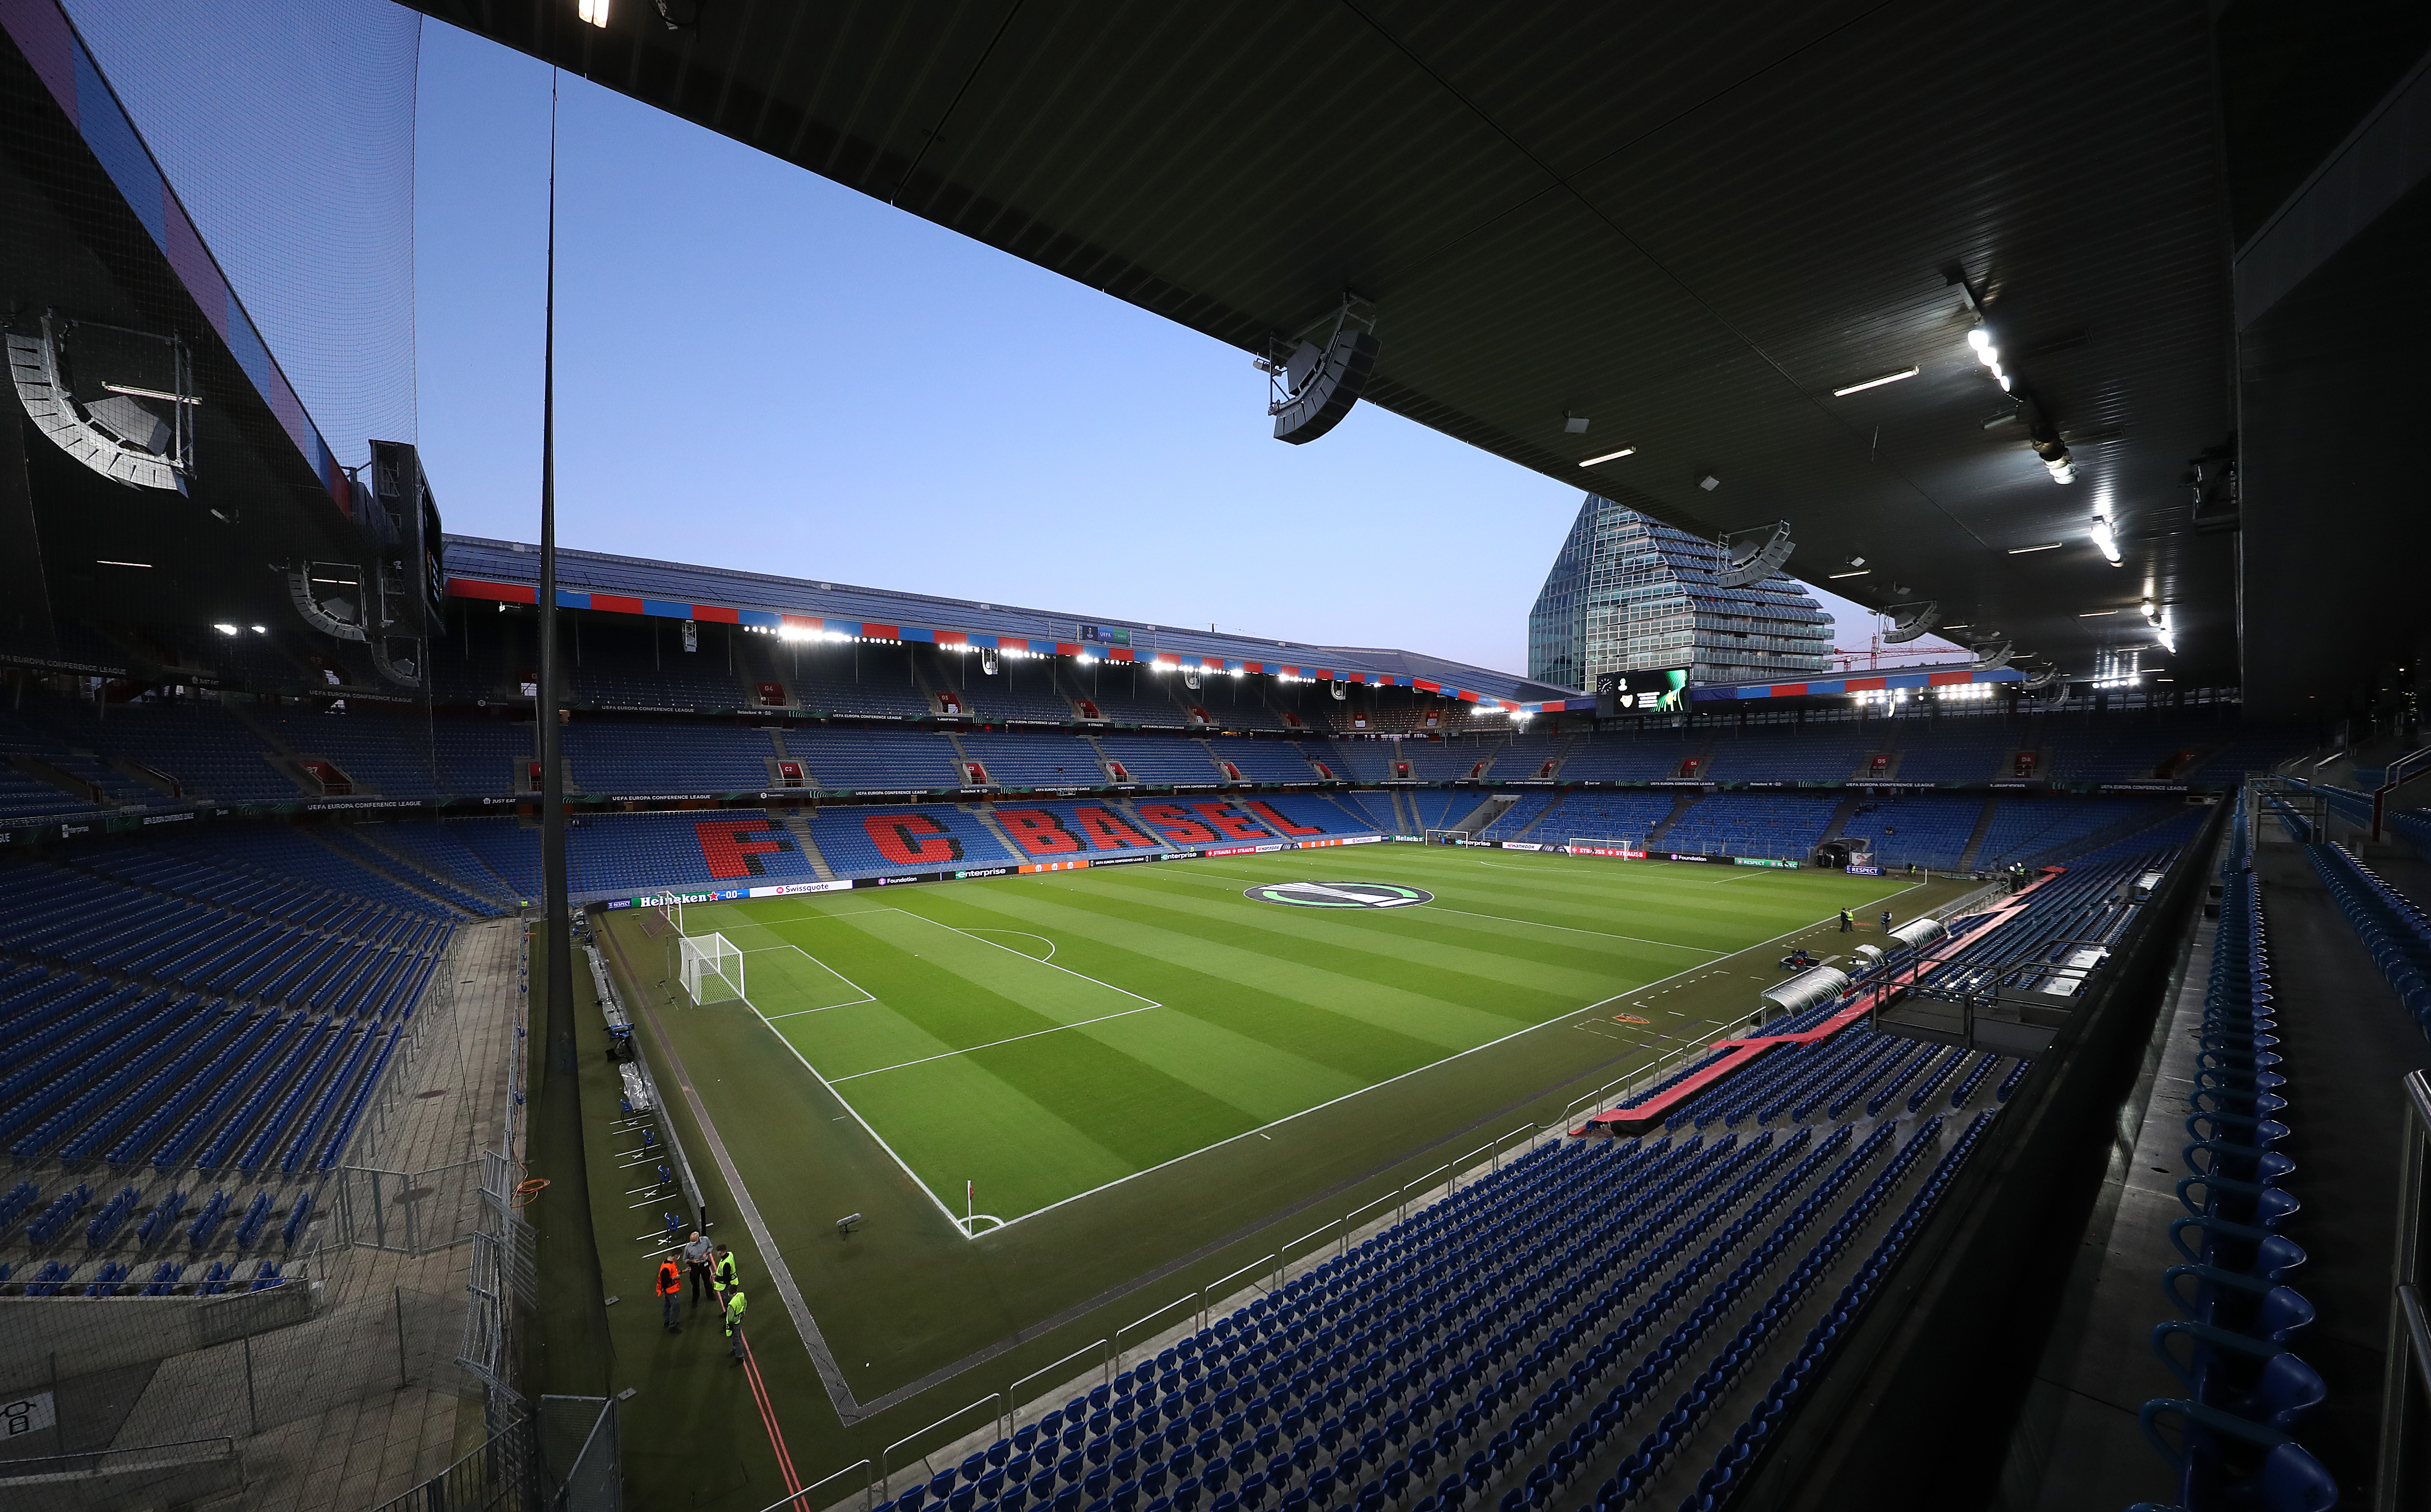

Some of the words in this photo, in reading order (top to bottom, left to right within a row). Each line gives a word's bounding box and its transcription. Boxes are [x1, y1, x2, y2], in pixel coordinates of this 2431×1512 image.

[13, 656, 46, 666] EUROPA
[47, 659, 97, 672] CONFERENCE
[99, 666, 127, 675] LEAGUE
[352, 693, 391, 702] CONFERENCE
[994, 801, 1326, 854] BASEL
[1162, 852, 1197, 861] enterprise
[956, 867, 1006, 878] enterprise
[785, 882, 829, 893] Swissquote
[640, 894, 707, 907] Heineken
